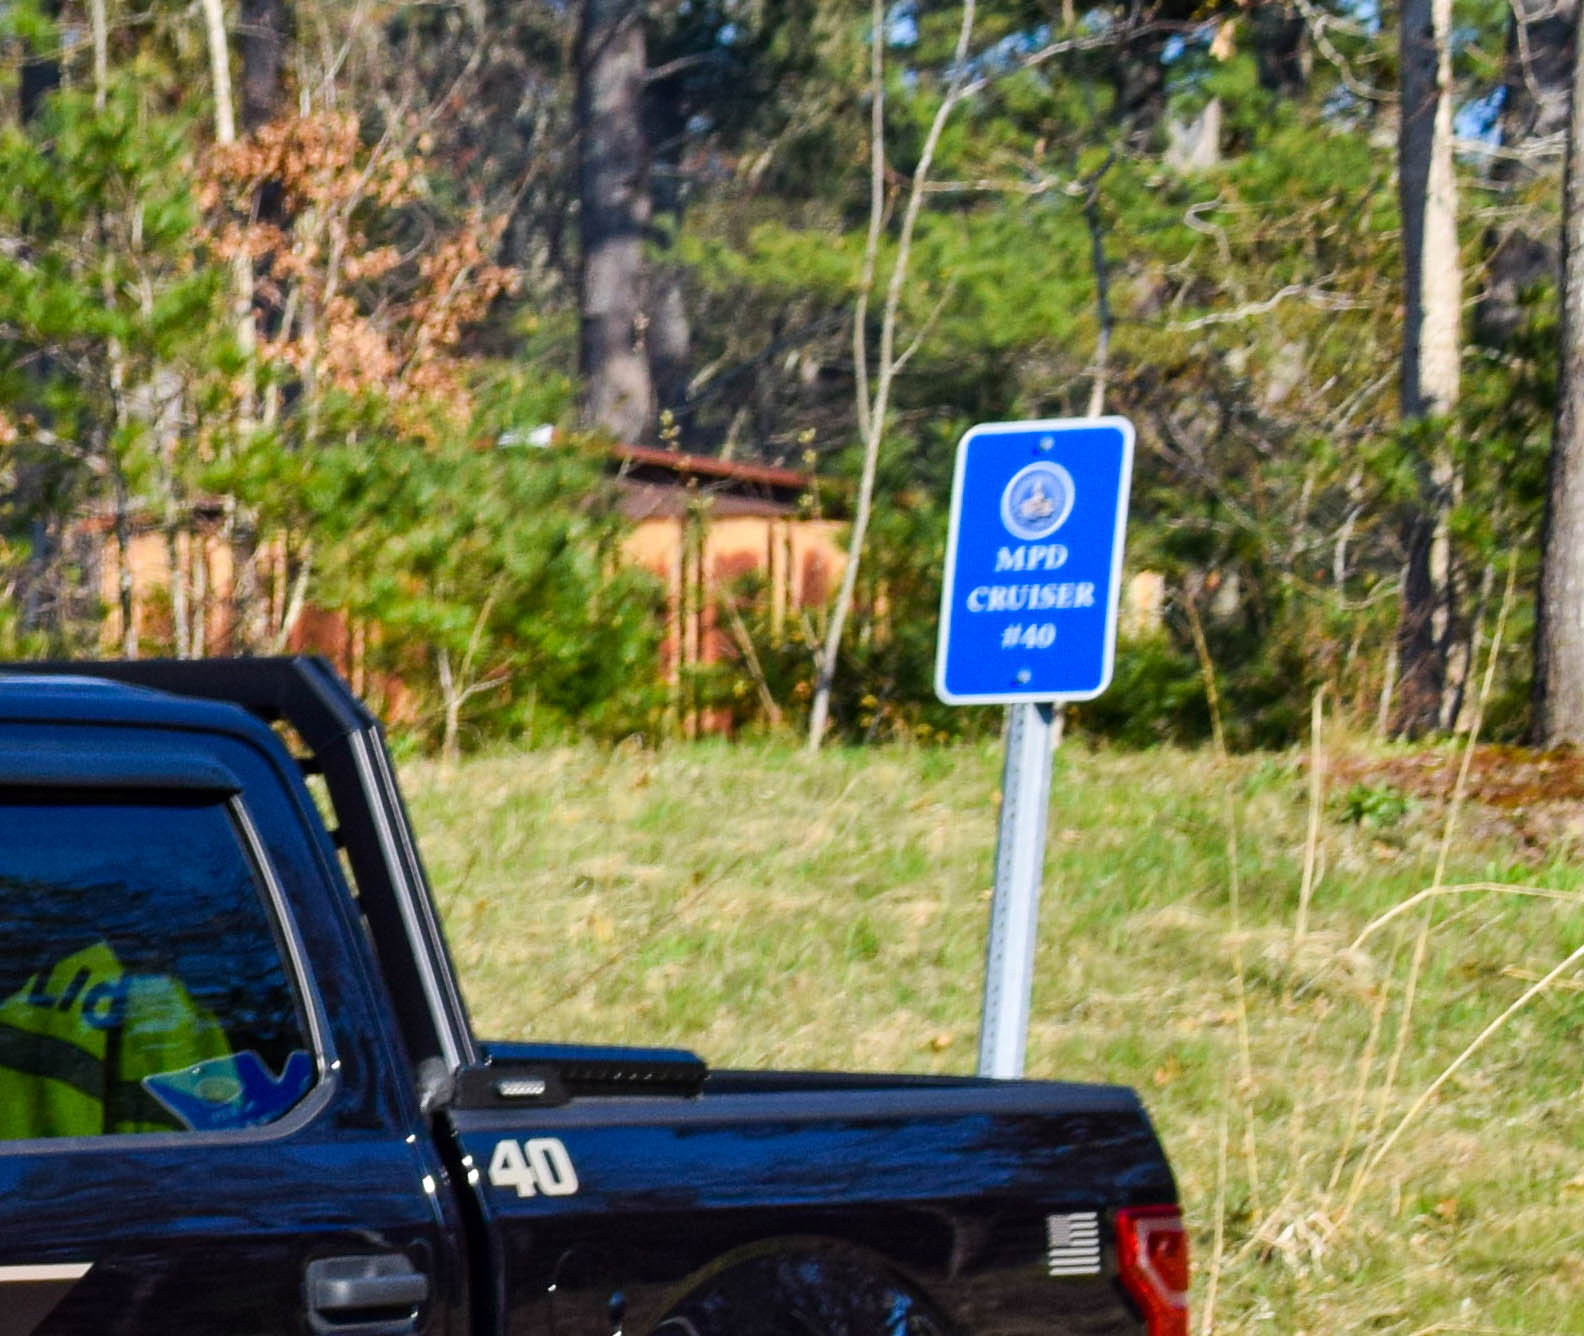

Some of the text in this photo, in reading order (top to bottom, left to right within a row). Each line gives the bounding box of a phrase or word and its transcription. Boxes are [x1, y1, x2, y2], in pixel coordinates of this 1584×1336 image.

[994, 544, 1068, 572] MPD
[966, 582, 1095, 612] CRUISER
[1001, 622, 1057, 650] #40
[488, 1136, 580, 1199] 40
